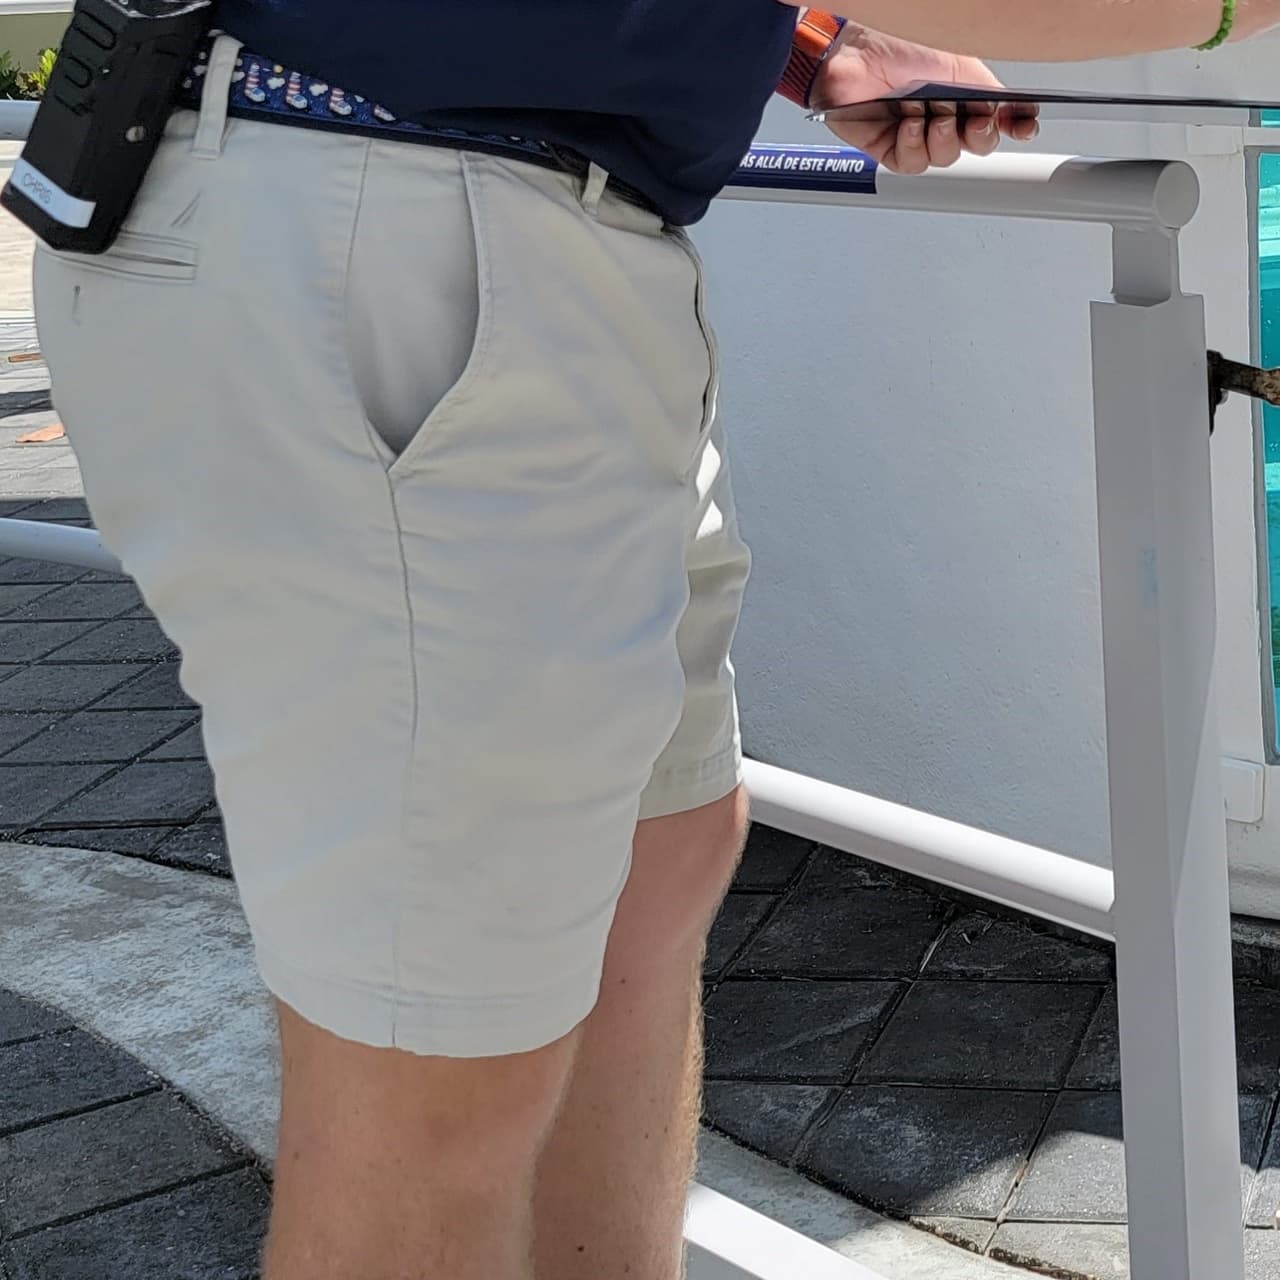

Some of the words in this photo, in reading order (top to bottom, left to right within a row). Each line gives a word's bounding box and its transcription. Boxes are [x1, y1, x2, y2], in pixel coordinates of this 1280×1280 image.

[739, 152, 757, 168] ÁS
[755, 153, 786, 169] ALLÁ
[783, 156, 799, 170] DE
[800, 159, 824, 172] ESTE
[824, 159, 865, 173] PUNTO
